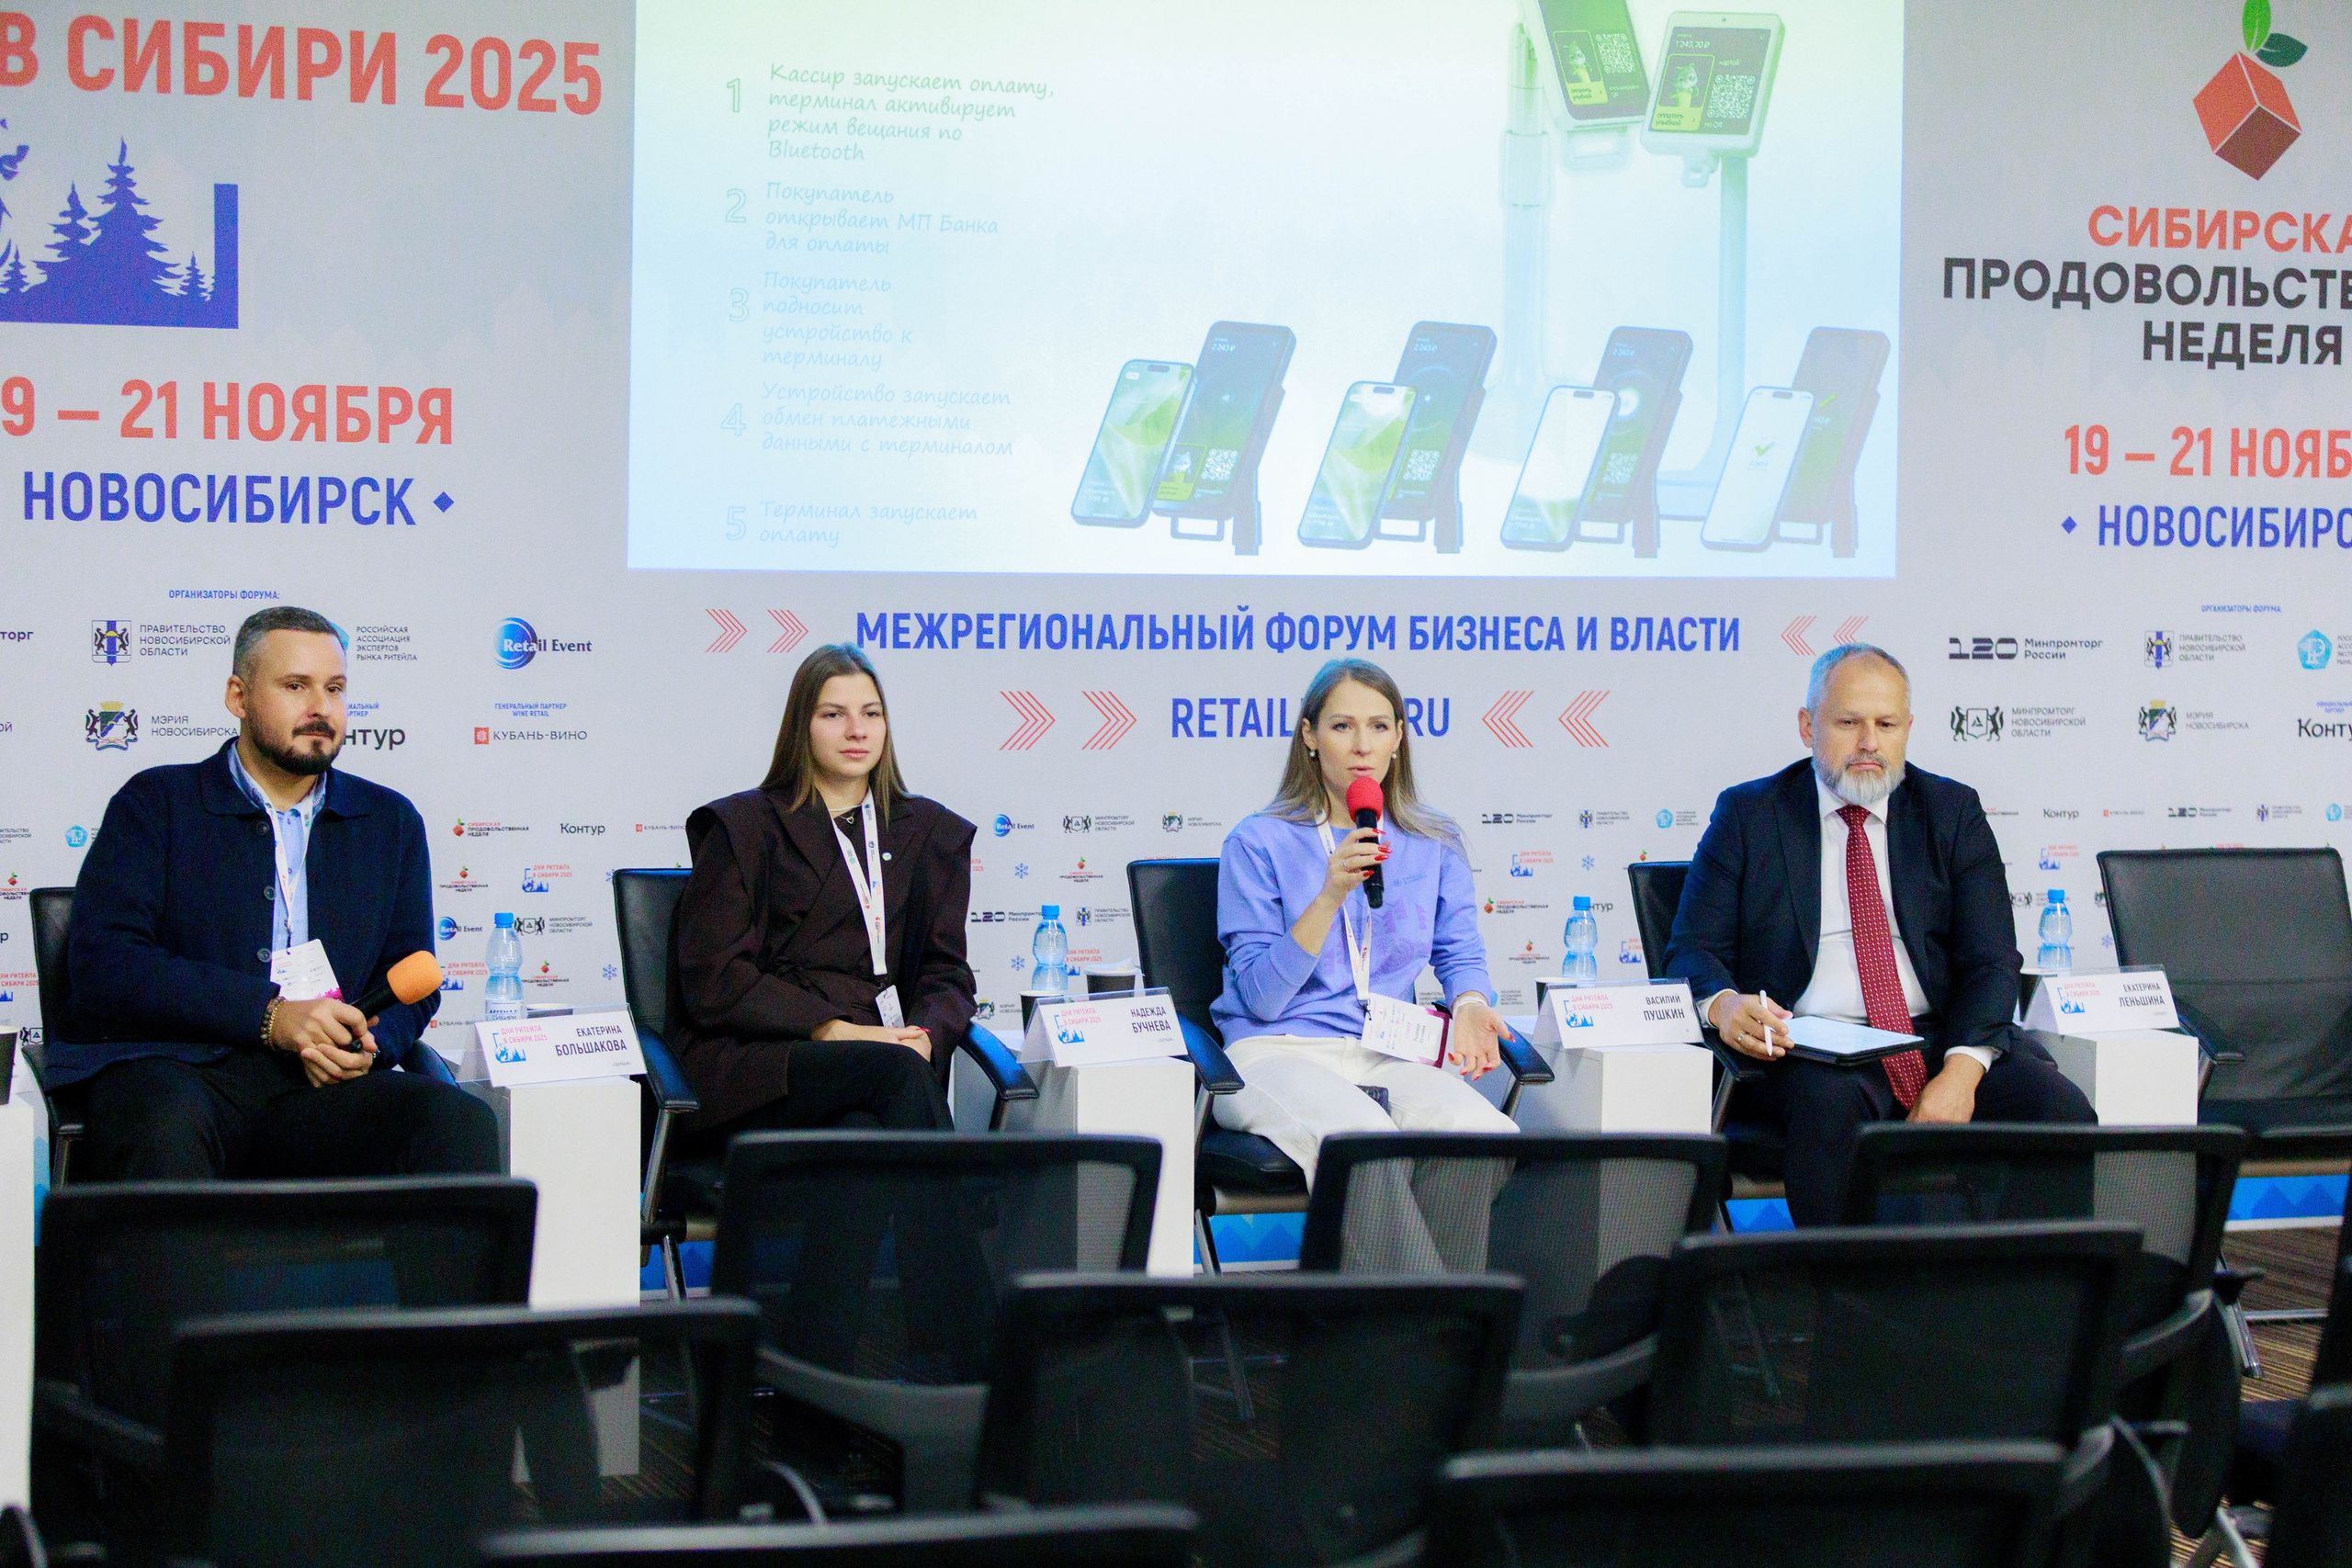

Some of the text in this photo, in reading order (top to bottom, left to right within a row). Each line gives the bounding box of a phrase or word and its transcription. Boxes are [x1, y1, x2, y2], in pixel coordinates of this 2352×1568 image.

[0, 12, 601, 115] В СИБИРИ 2025
[770, 62, 1055, 100] Кассир запускает оплату,
[726, 77, 741, 113] 1
[769, 92, 1016, 122] терминал активирует
[767, 117, 962, 141] режим вещания по
[768, 140, 865, 162] Bluetooth
[765, 182, 895, 205] Покупатель
[725, 187, 747, 223] 2
[765, 208, 999, 234] открывает МП Банка
[765, 231, 889, 254] для оплаты
[763, 270, 892, 293] Покупатель
[729, 287, 750, 322] 3
[763, 297, 865, 316] подносит
[763, 322, 912, 345] устройство к
[2143, 321, 2342, 370] НЕДЕЛЯ
[763, 350, 882, 372] терминалу
[762, 381, 1012, 409] Устройство запускает
[120, 379, 177, 439] 21
[202, 381, 452, 445] НОЯБРЯ
[720, 402, 747, 436] 4
[763, 409, 971, 430] обмен платежными
[762, 431, 1012, 459] данными с терминалом
[2064, 424, 2109, 475] 19
[2170, 426, 2212, 476] 21
[2231, 427, 2352, 479] НОЯБ
[24, 471, 415, 525] НОВОСИБИРСК
[760, 500, 978, 525] Терминал запускает
[725, 505, 747, 541] 5
[2098, 504, 2352, 549] НОВОСИБИРС
[759, 526, 840, 548] оплату
[169, 590, 238, 599] ОРГАНИЗАТОРЫ
[140, 625, 226, 634] ПРАВИТЕЛЬСТВО
[356, 625, 408, 634] РОССИЙСКАЯ
[856, 605, 1739, 653] МЕЖРЕГИОНАЛЬНЫЙ ФОРУМ БИЗНЕСА И ВЛАСТИ
[140, 635, 231, 645] НОВОСИБИРСКОЙ
[503, 639, 592, 652] Retail Event
[2024, 638, 2103, 649] Минпромторг
[140, 648, 188, 657] ОБЛАСТИ
[384, 653, 417, 661] РИТЕЙЛА
[2024, 650, 2065, 660] России
[347, 702, 379, 710] ИАЛЬНЫЙ
[495, 702, 538, 710] ГЕНЕРАЛЬНЫЙ
[2012, 707, 2075, 716] МИНПРОМТОРГ
[151, 716, 188, 725] МЭРИЯ
[2012, 716, 2086, 727] НОВОСИБИРСКОЙ
[151, 728, 238, 737] НОВОСИБИРСКА
[344, 728, 406, 750] нтур
[493, 730, 588, 741] КУБАНЬ-ВИНО
[2011, 729, 2051, 738] ОБЛАСТИ
[2043, 808, 2080, 819] Контур
[560, 823, 605, 835] Контур
[2122, 982, 2161, 993] ЕКАТЕРИНА
[1645, 993, 1680, 1005] ВАСИЛИЙ
[2119, 995, 2165, 1008] ЛЕНЬШИНА
[1130, 1006, 1167, 1018] НАДЕЖДА
[1644, 1009, 1685, 1021] ПУШКИН
[576, 1025, 622, 1037] ЕКАТЕРИНА
[1132, 1020, 1171, 1033] БУЧНЕВА
[555, 1039, 628, 1056] БОЛЬШАКОВА
